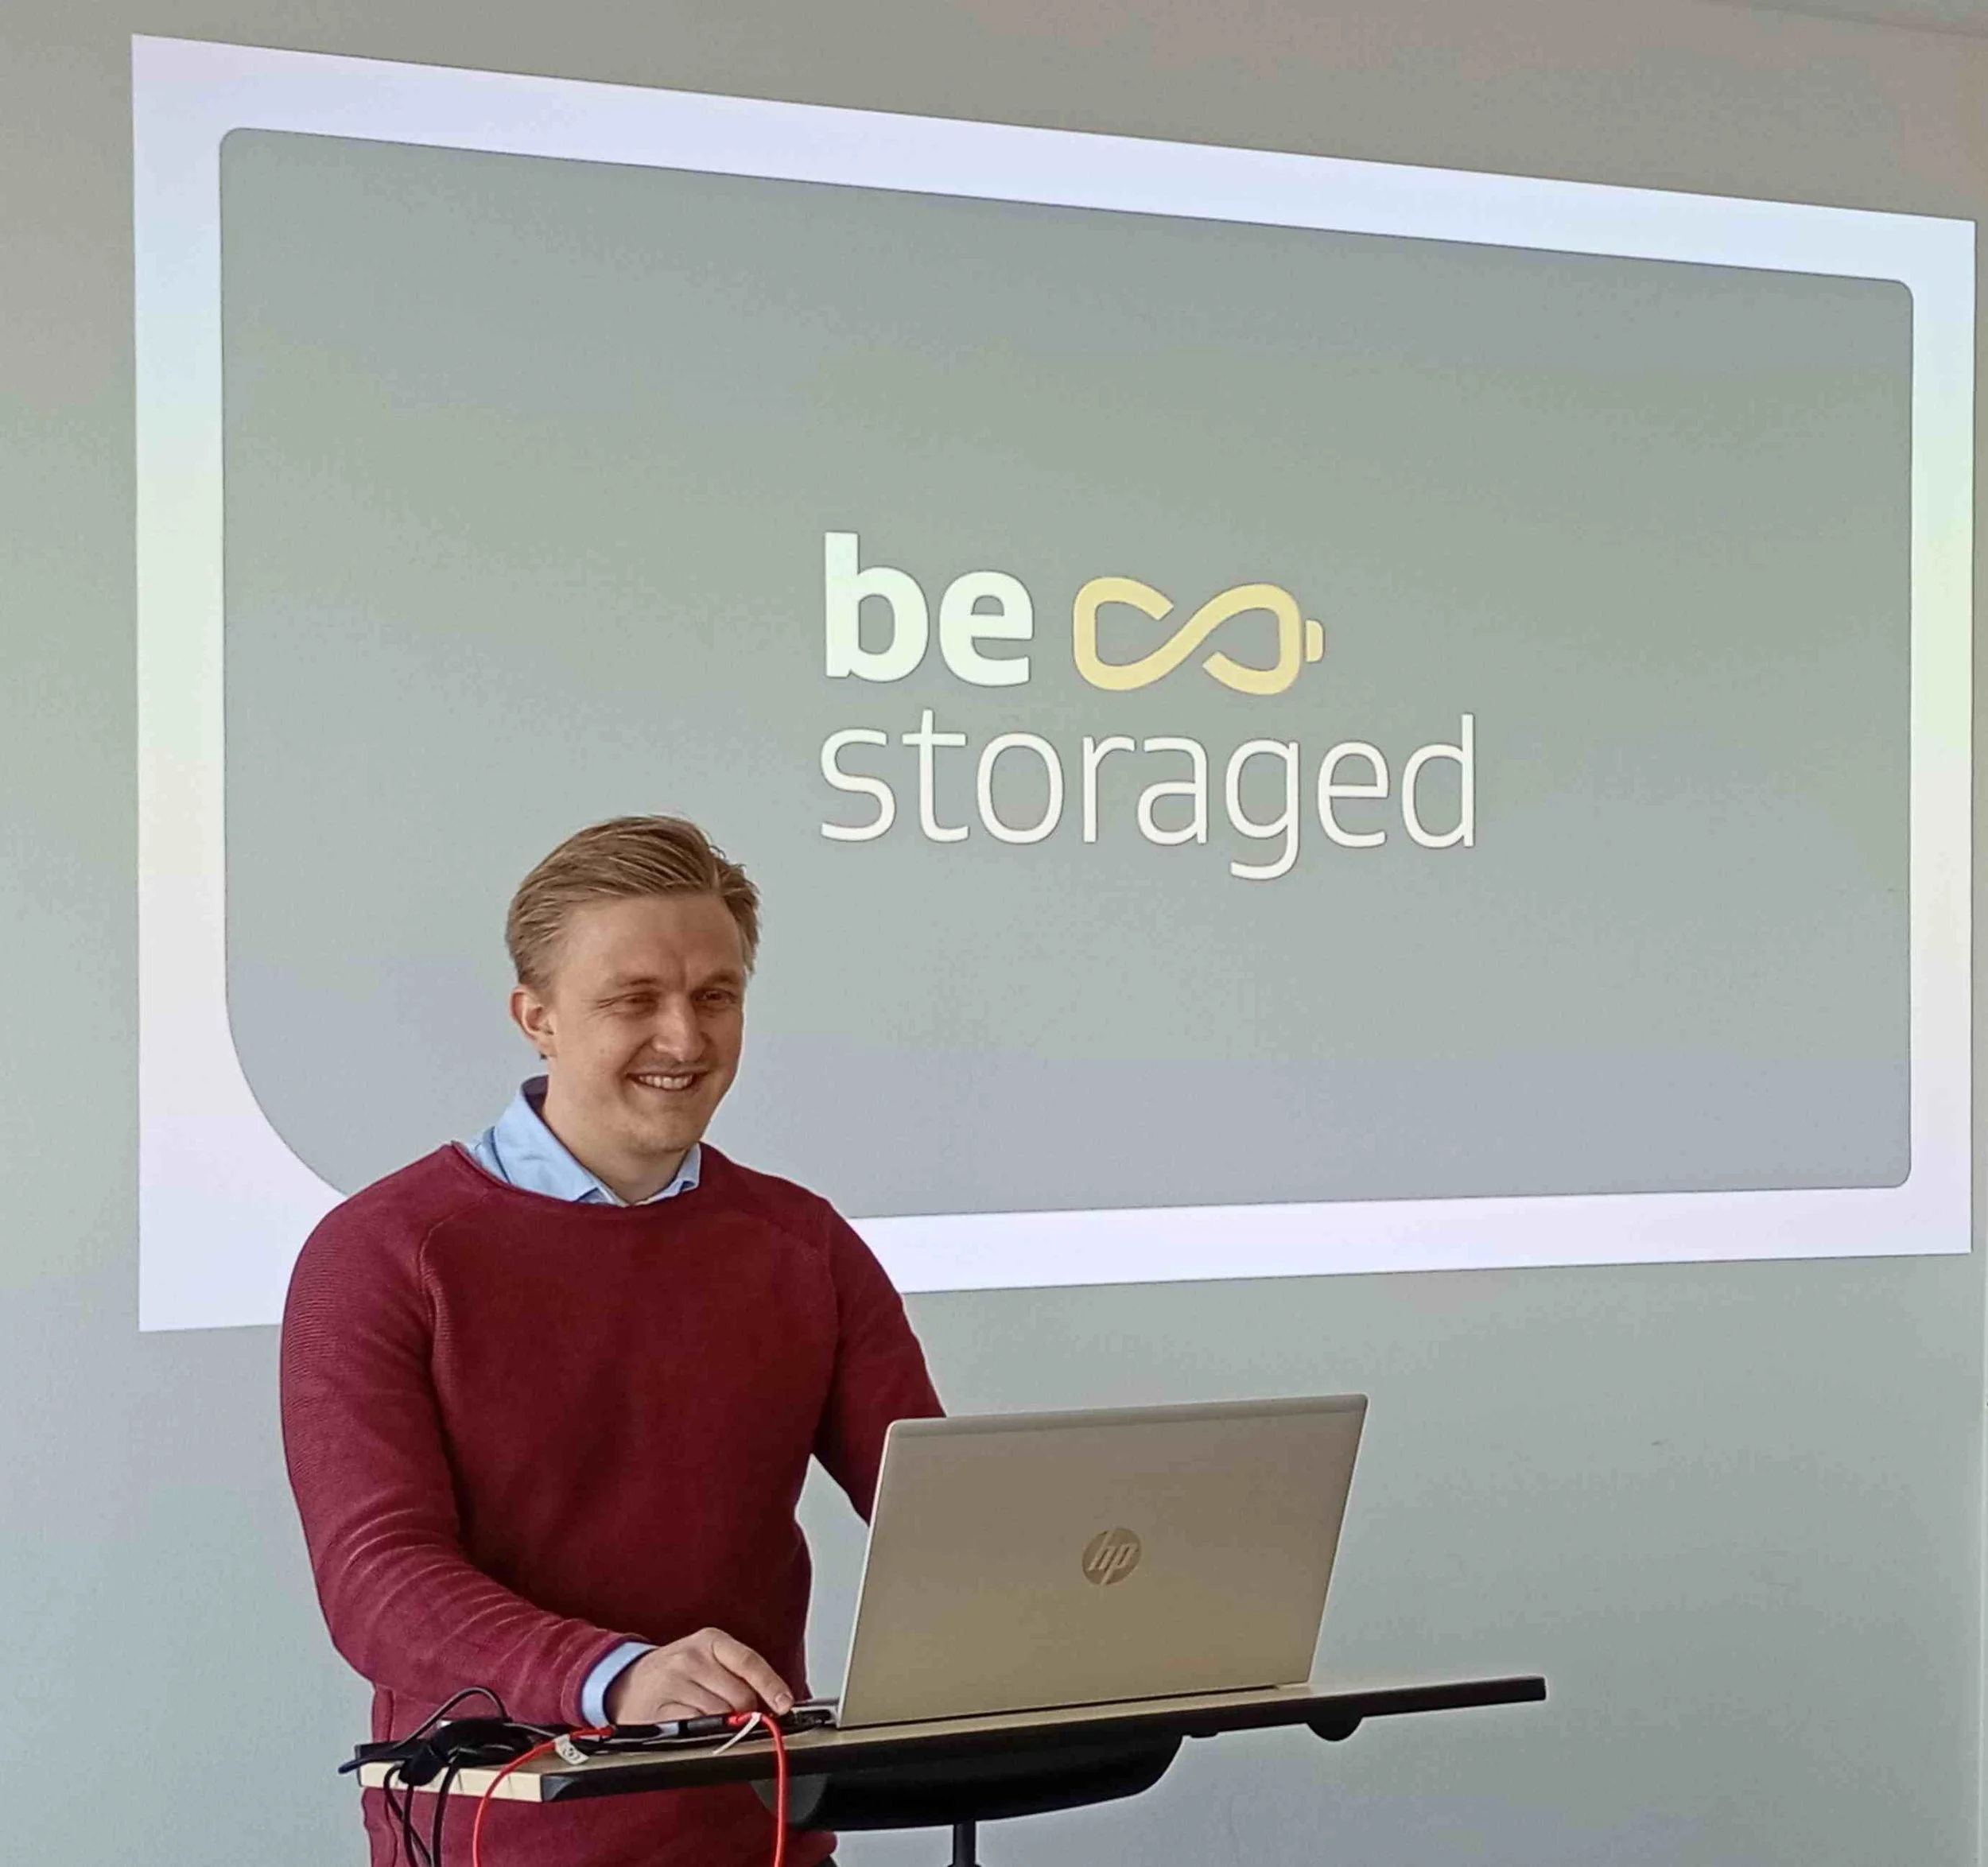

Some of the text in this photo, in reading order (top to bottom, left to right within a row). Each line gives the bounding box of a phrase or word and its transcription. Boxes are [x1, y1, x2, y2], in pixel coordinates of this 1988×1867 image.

[823, 531, 1034, 687] be
[820, 708, 1476, 880] storaged
[1087, 1528, 1139, 1586] hp
